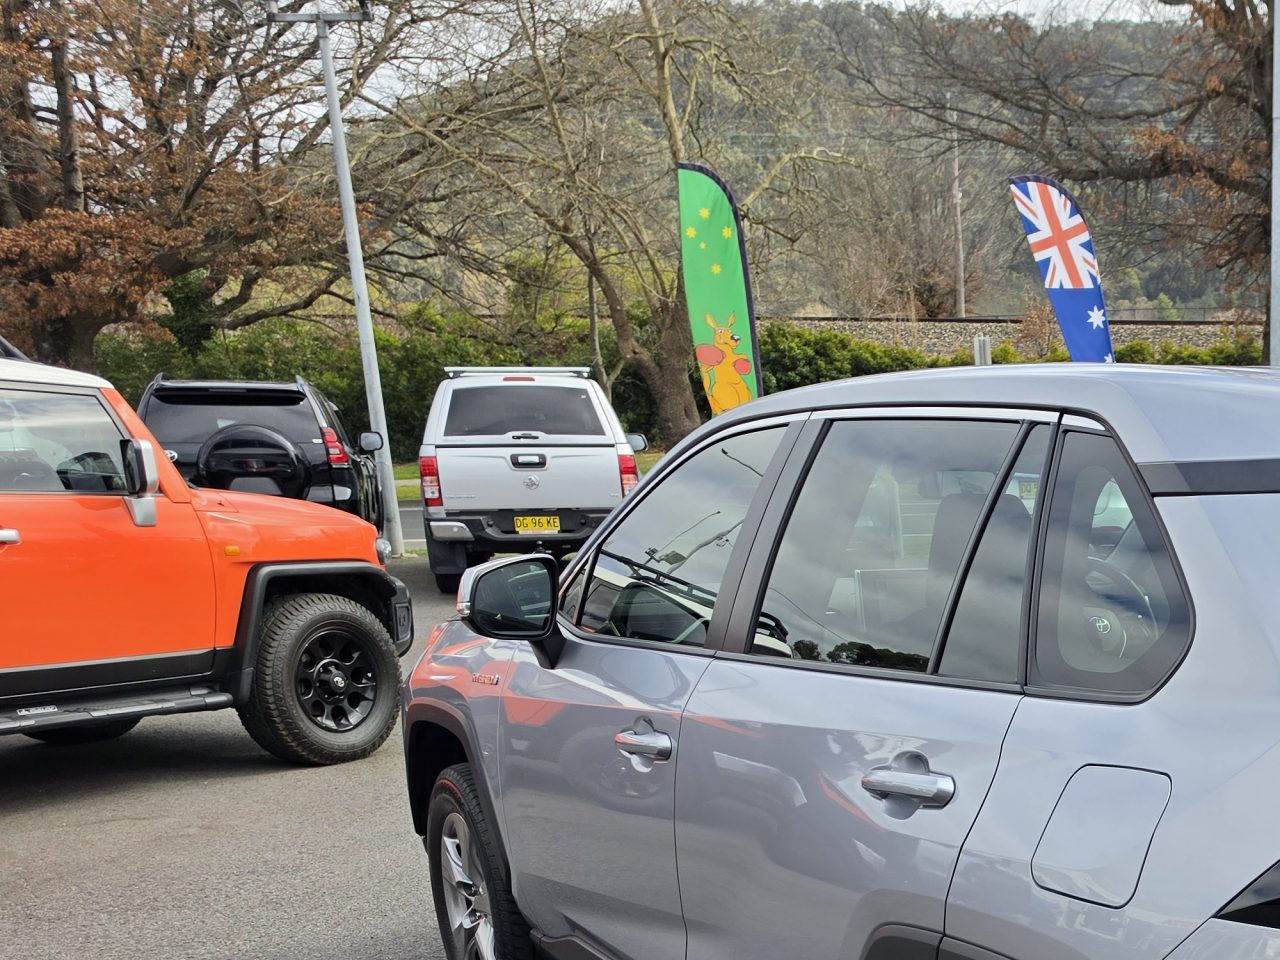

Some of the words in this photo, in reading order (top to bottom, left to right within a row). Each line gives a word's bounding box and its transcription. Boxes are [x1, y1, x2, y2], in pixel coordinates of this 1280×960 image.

[515, 518, 528, 528] DG
[531, 518, 543, 528] 96
[546, 517, 559, 528] KE
